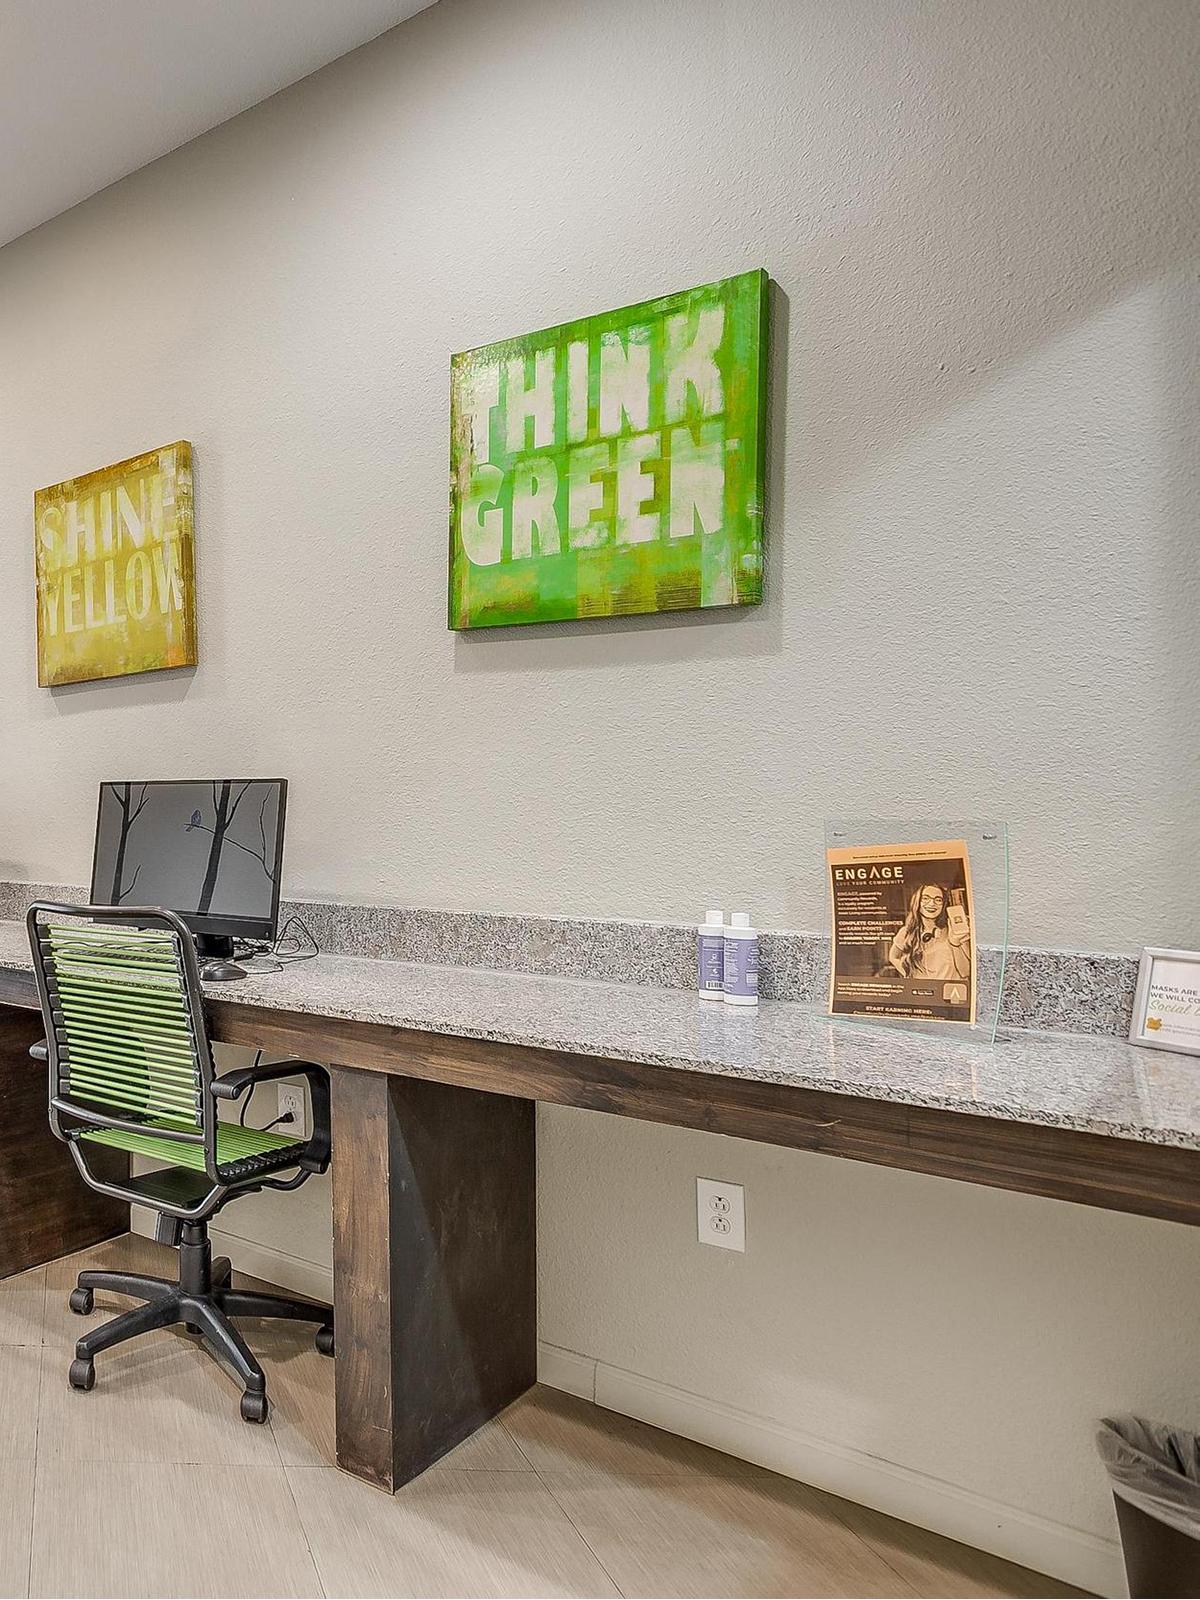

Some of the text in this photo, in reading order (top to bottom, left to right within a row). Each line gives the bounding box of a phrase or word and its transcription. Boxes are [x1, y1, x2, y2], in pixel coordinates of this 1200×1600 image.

[462, 309, 726, 463] THINK
[39, 466, 178, 571] SHINE
[461, 421, 726, 566] GREEN
[44, 539, 183, 637] YELLOW
[835, 866, 903, 880] ENGAGE
[1150, 999, 1191, 1014] Social
[1151, 985, 1179, 993] MASKS
[1165, 994, 1187, 1002] WILL
